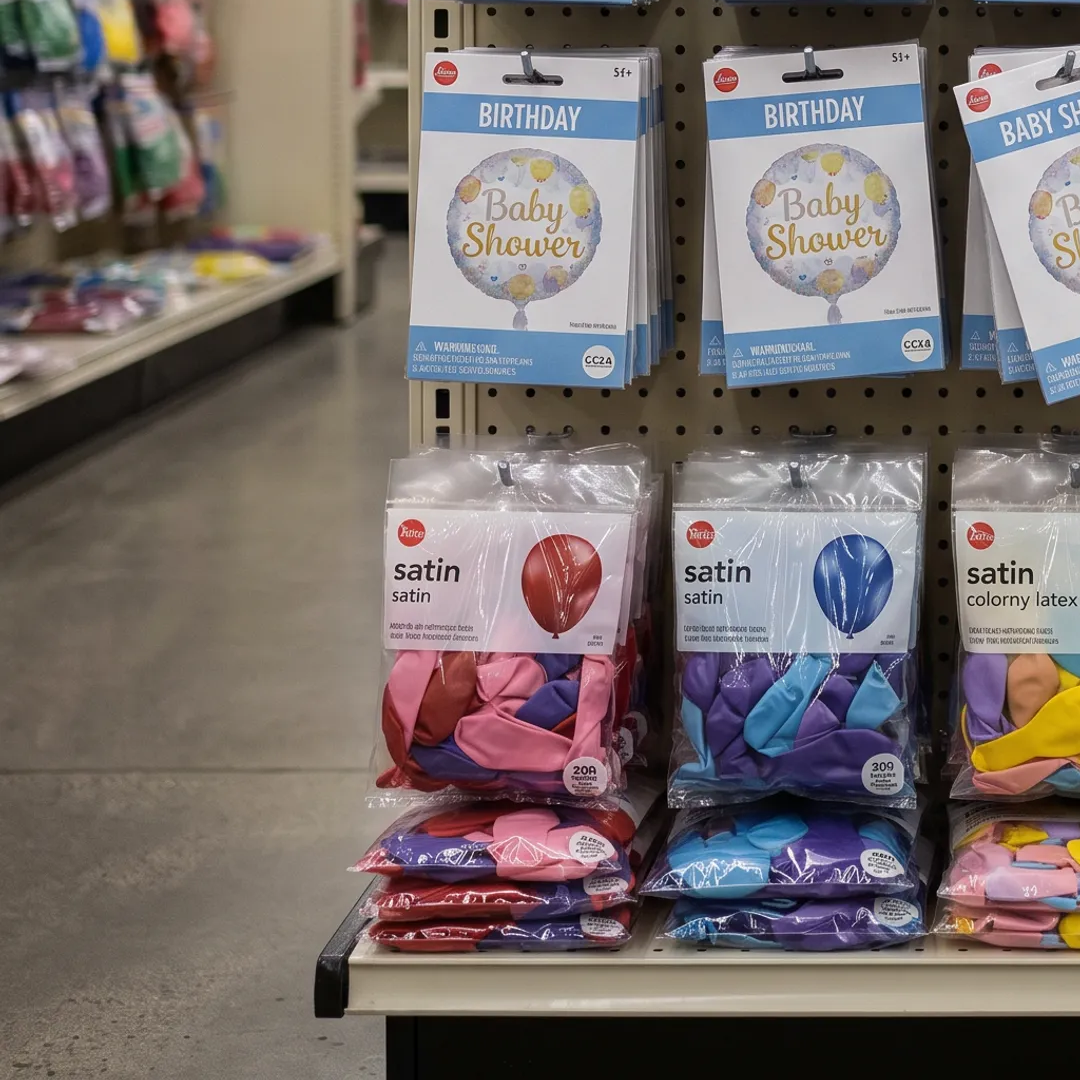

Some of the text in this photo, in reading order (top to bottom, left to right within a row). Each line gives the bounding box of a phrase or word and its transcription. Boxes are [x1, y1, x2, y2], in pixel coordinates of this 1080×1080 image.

[479, 102, 581, 131] BIRTHDAY
[764, 96, 865, 129] BIRTHDAY
[999, 115, 1054, 147] BABY
[482, 188, 568, 234] Baby
[777, 181, 864, 226] Baby
[461, 221, 585, 259] Shower
[766, 223, 887, 261] Shower
[394, 558, 460, 582] satin
[684, 559, 751, 582] satin
[967, 560, 1033, 584] satin
[392, 588, 431, 602] satin
[684, 590, 722, 604] satin
[1036, 591, 1078, 607] latex
